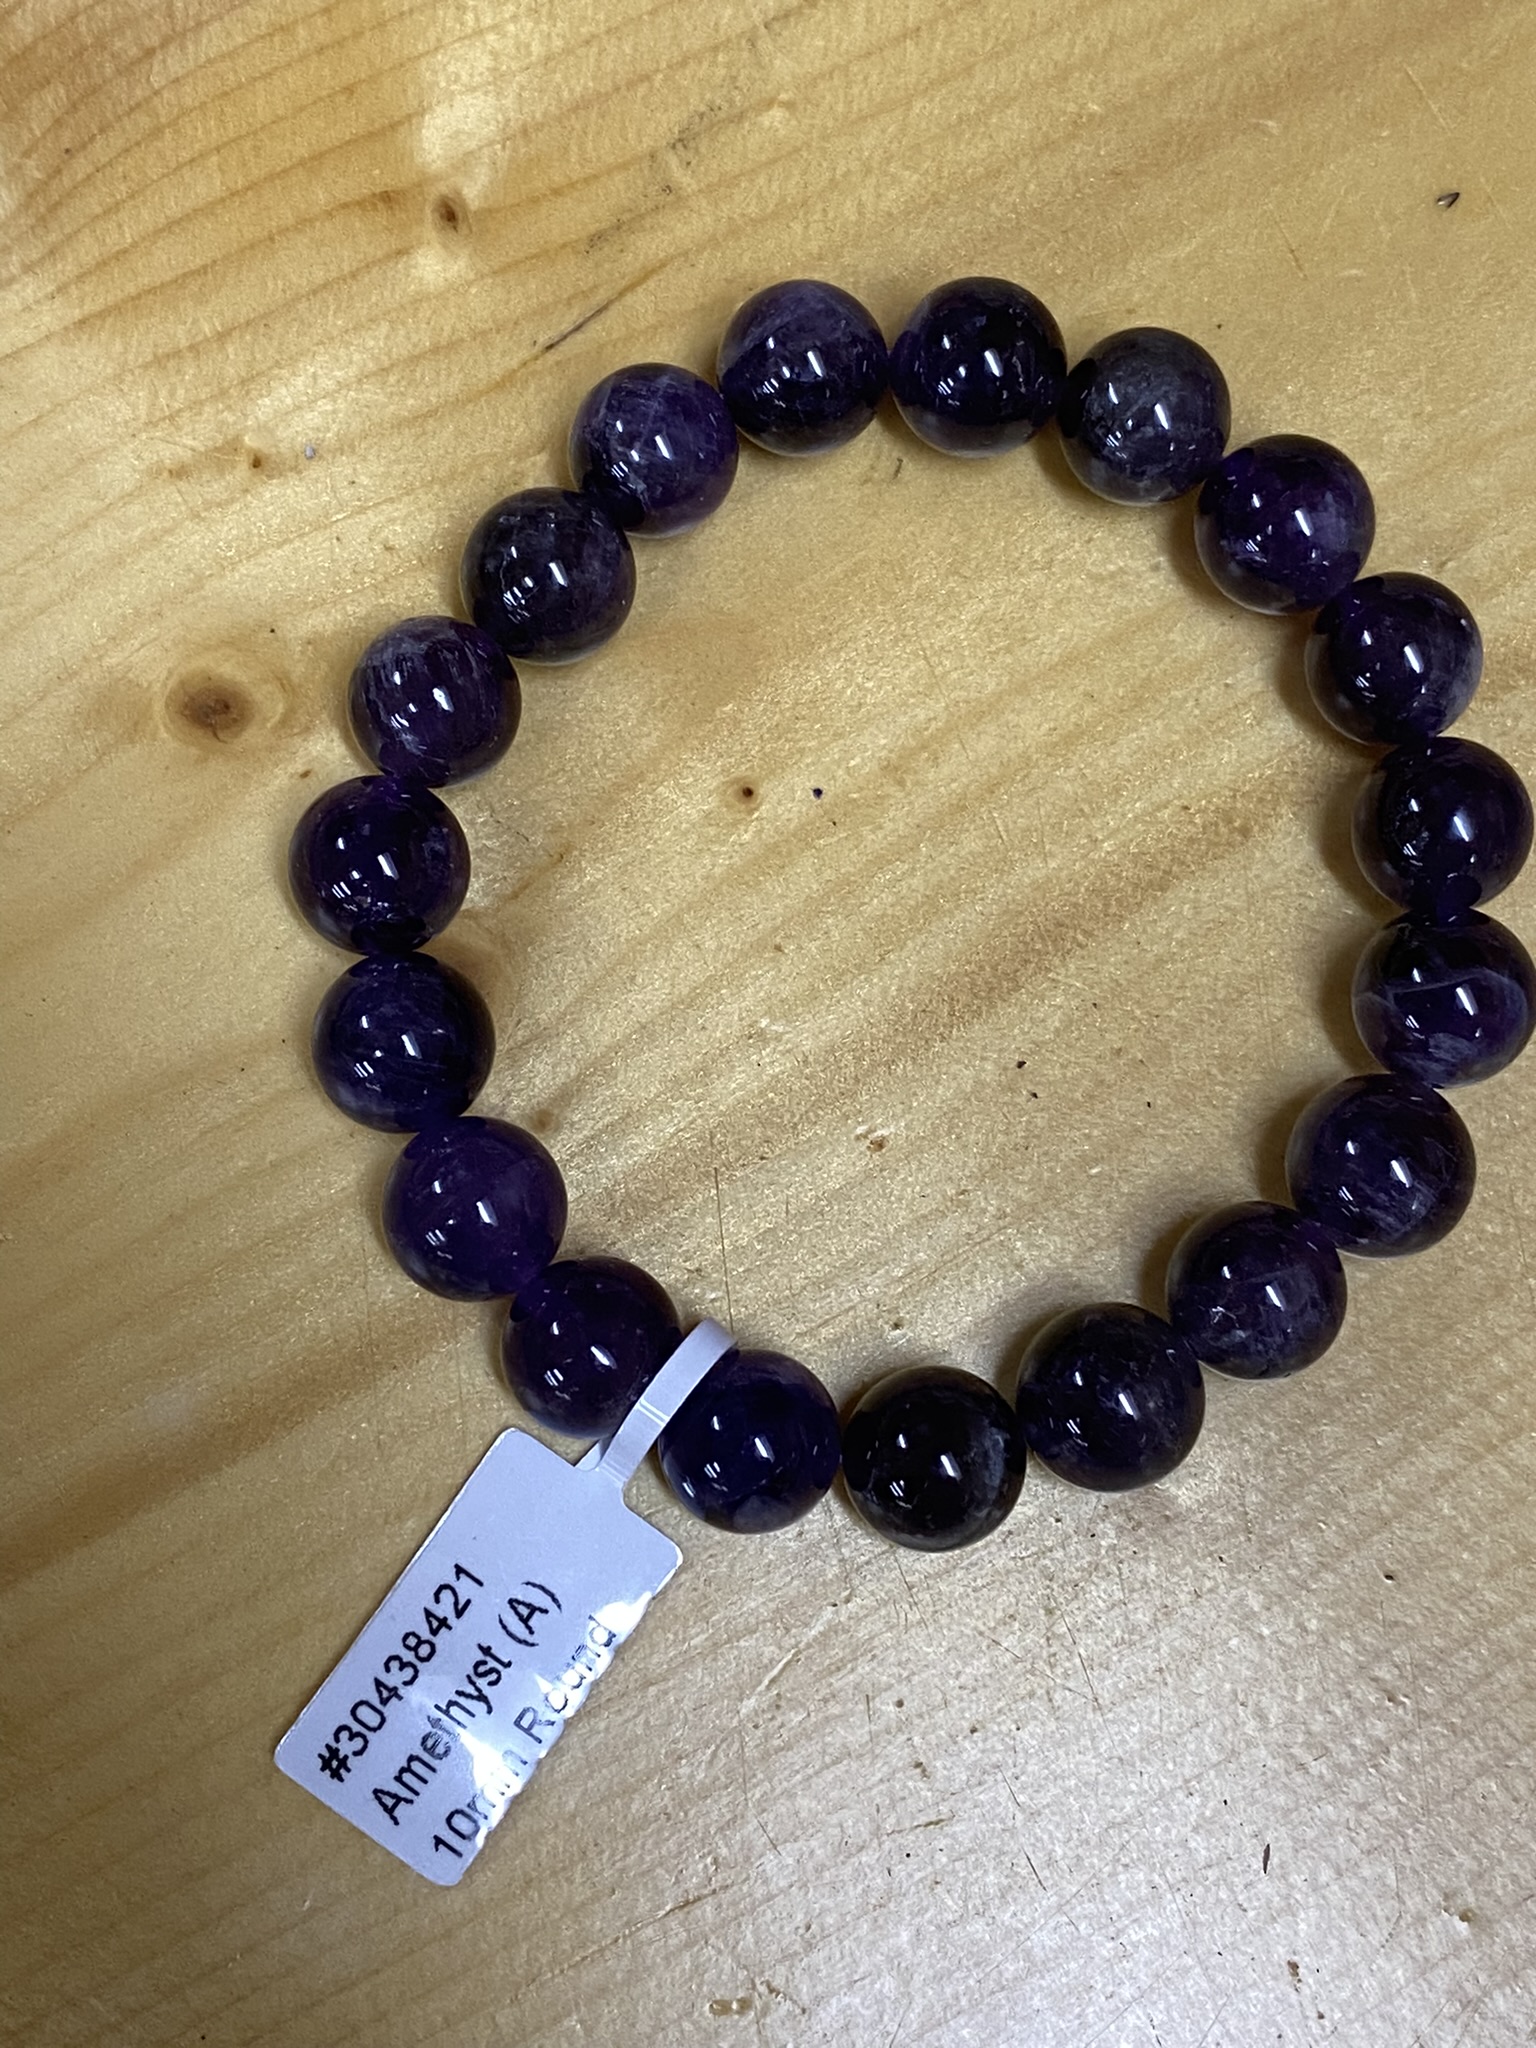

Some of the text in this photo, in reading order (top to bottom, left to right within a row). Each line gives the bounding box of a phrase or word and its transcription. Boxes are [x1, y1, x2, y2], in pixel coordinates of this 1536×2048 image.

[317, 1563, 485, 1783] #30438421
[371, 1580, 563, 1826] Amethyst (A)
[513, 1614, 617, 1744] Round
